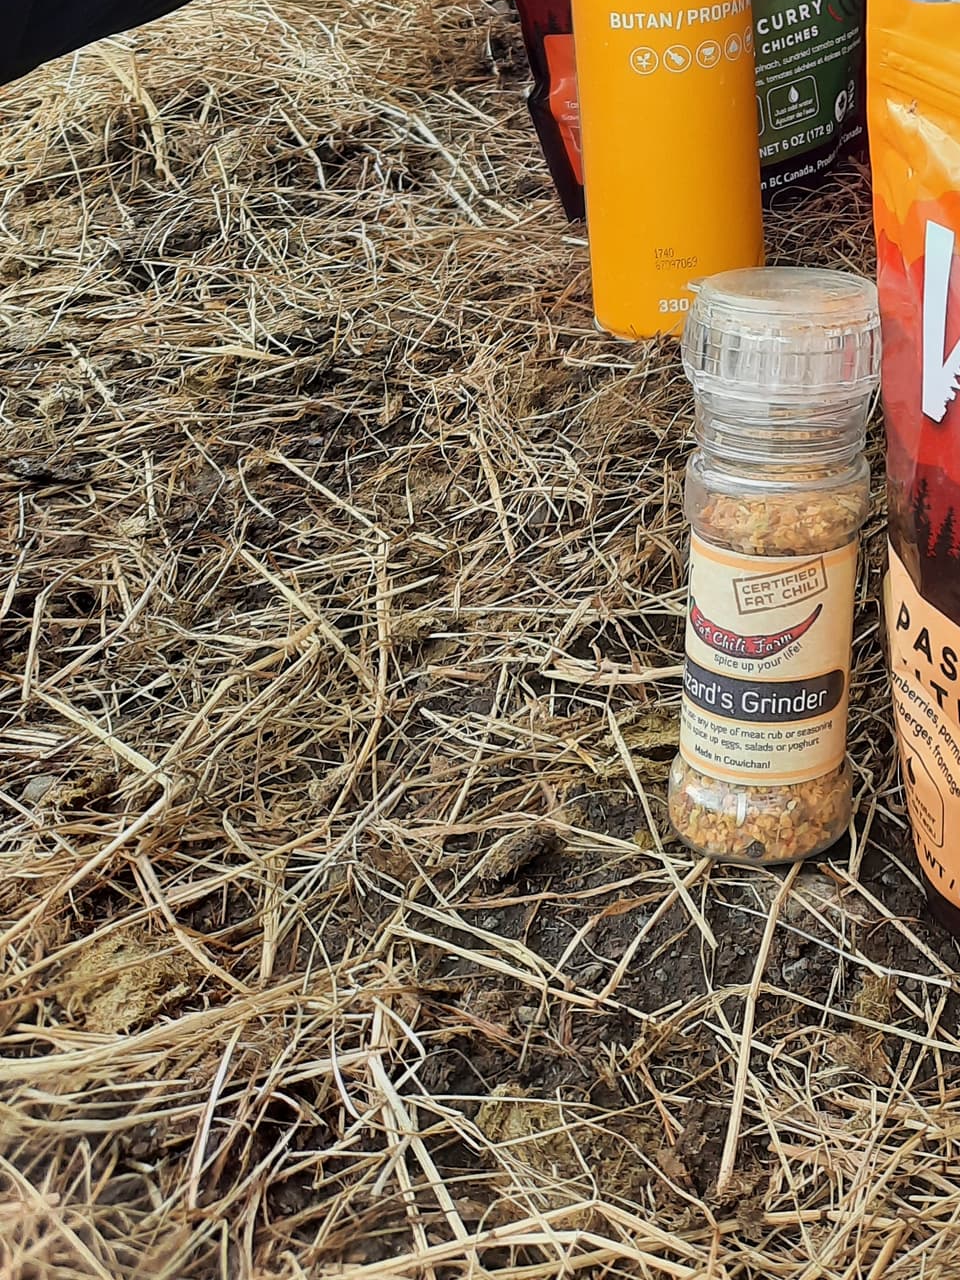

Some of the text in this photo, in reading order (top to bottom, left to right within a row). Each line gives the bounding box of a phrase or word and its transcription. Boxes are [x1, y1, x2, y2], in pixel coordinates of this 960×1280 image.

[762, 25, 819, 54] CHICHES
[759, 142, 780, 158] NET
[782, 139, 789, 150] 6
[790, 133, 805, 147] OZ
[806, 126, 824, 143] (172
[769, 175, 783, 188] BC
[659, 297, 690, 313] 330
[741, 567, 818, 595] CERTIFIED
[744, 577, 819, 608] FAT CHILI
[712, 631, 746, 653] Chili
[752, 633, 793, 654] Farm
[714, 653, 738, 669] spice
[741, 661, 754, 672] up
[757, 656, 783, 674] your
[741, 689, 828, 715] Grinder
[891, 671, 939, 729] anberries,
[710, 723, 728, 736] type
[729, 727, 741, 737] of
[741, 730, 765, 739] meat
[767, 730, 782, 740] rub
[785, 730, 796, 738] or
[894, 698, 933, 750] nberges,
[709, 734, 719, 744] up
[744, 741, 774, 752] salads
[775, 743, 786, 752] or
[788, 736, 820, 753] yoghurt
[714, 752, 722, 762] in
[923, 843, 947, 880] WT
